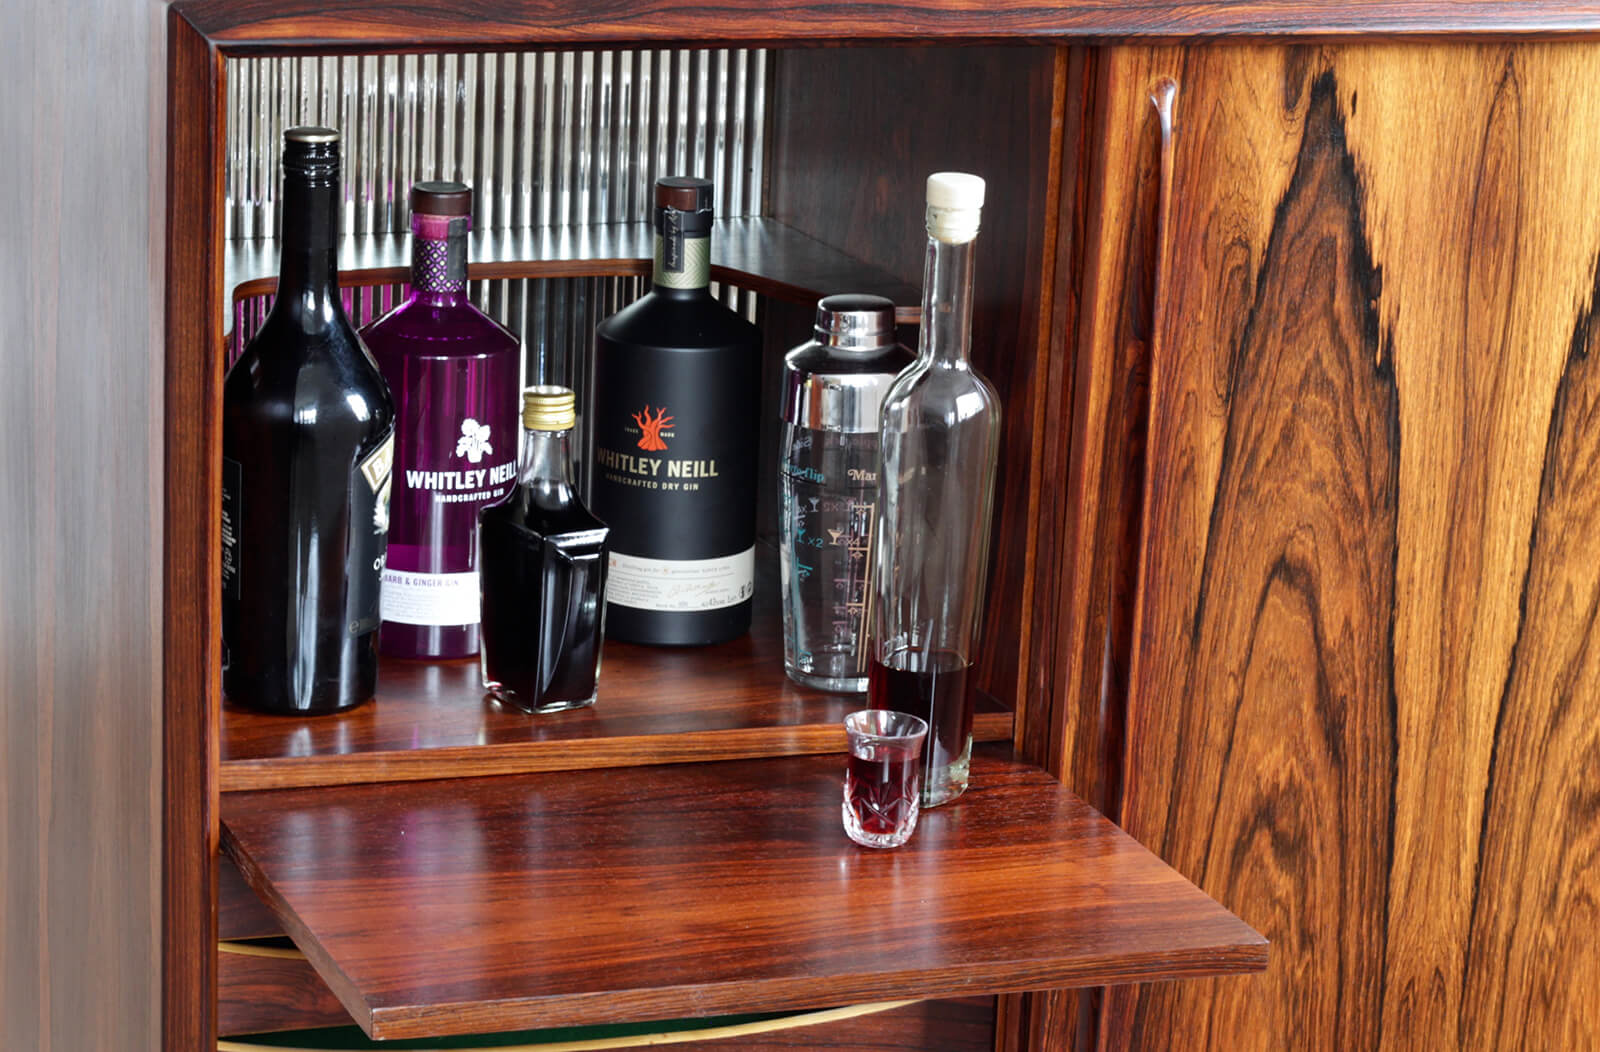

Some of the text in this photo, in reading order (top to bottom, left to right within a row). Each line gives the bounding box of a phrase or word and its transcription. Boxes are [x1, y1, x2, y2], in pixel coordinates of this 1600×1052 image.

[597, 447, 719, 478] WHITLEY NEILL
[405, 469, 487, 490] WHITLEY
[661, 482, 680, 491] DRY
[683, 482, 699, 491] GIN
[435, 488, 505, 503] HANDCRAFTED GIN
[405, 577, 410, 585] &
[413, 578, 442, 587] GINGER
